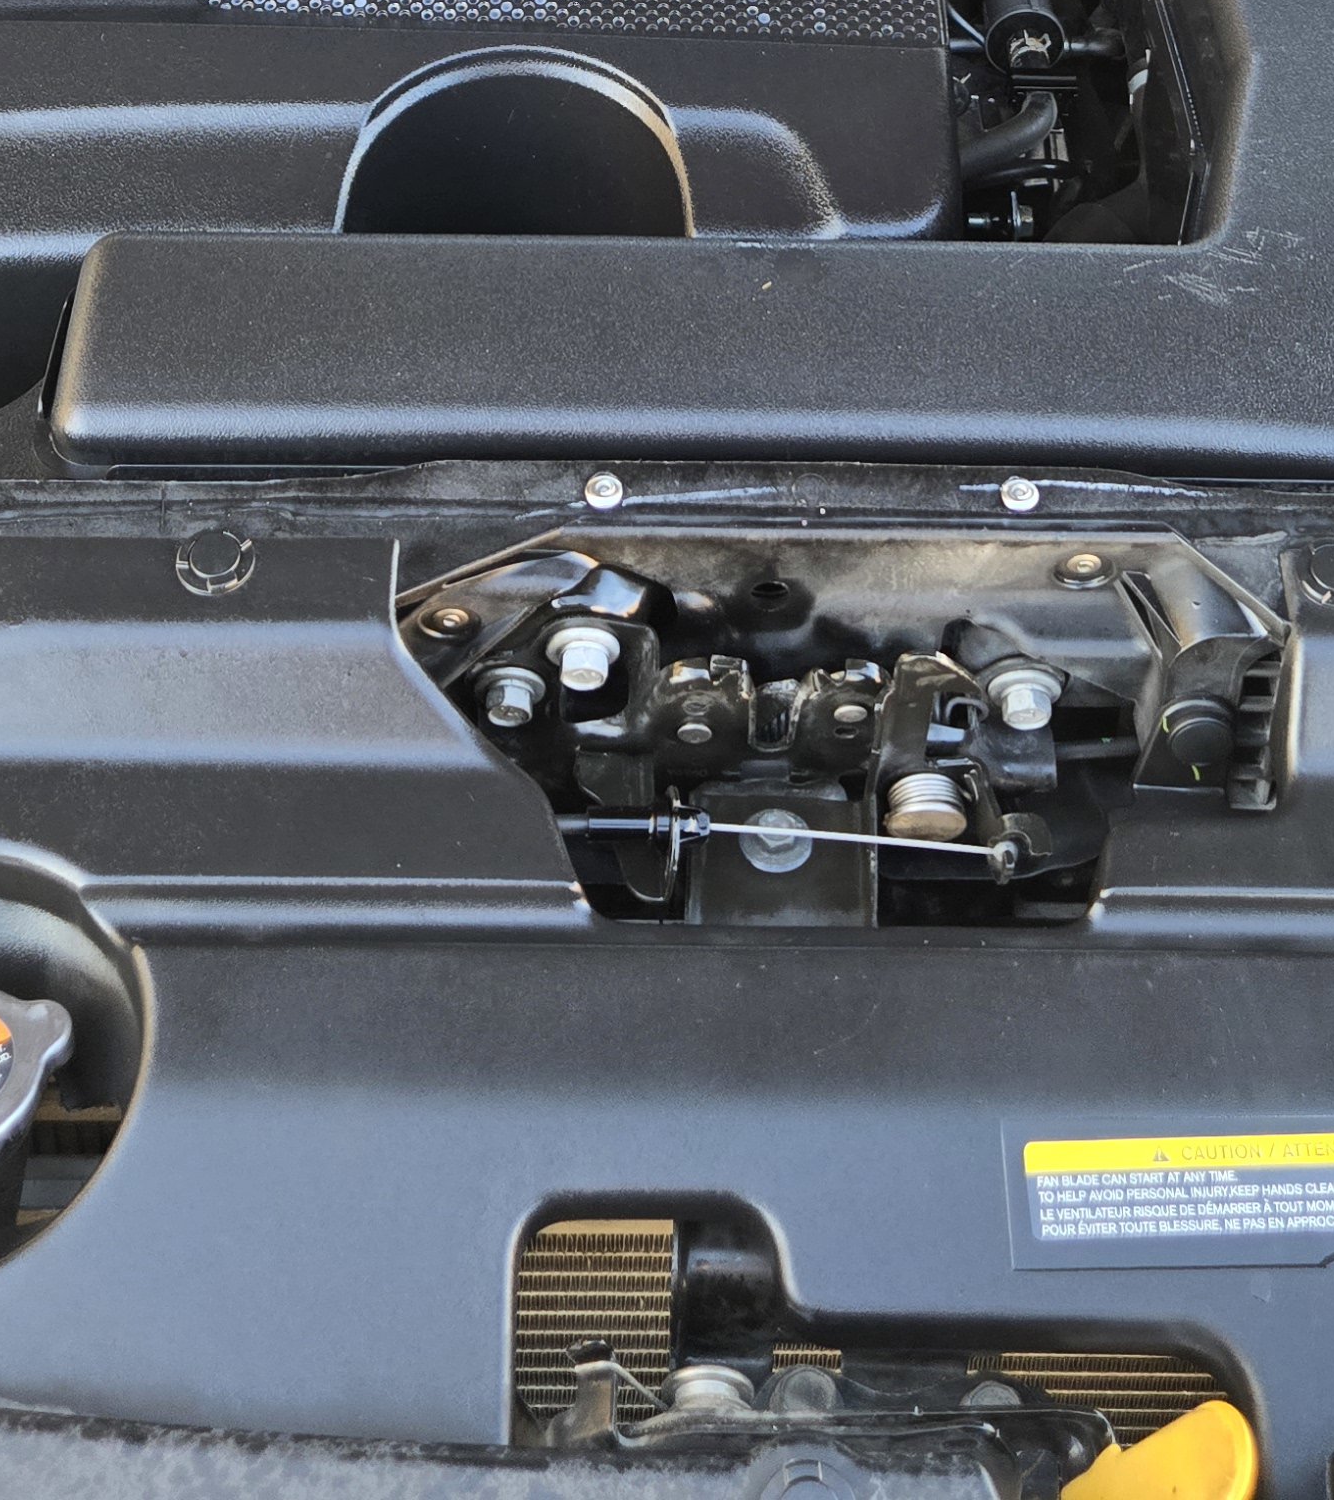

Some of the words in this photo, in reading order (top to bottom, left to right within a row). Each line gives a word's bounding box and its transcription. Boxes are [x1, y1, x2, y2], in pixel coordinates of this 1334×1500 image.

[1182, 1144, 1261, 1161] CAUTION
[1037, 1176, 1059, 1188] FAN
[1062, 1174, 1099, 1186] BLADE
[1102, 1174, 1127, 1184] CAN
[1129, 1172, 1165, 1184] START
[1167, 1172, 1180, 1182] AT
[1183, 1171, 1206, 1182] ANY
[1209, 1170, 1237, 1181] TIME.
[1039, 1191, 1054, 1202] TO
[1057, 1190, 1086, 1202] HELP
[1089, 1189, 1123, 1201] AVOID
[1127, 1187, 1187, 1200] PERSONAL
[1263, 1184, 1302, 1196] HANDS
[1040, 1209, 1055, 1220] LE
[1057, 1206, 1131, 1220] VENTILATEUR
[1133, 1205, 1175, 1218] RISQUE
[1176, 1204, 1195, 1215] DE
[1198, 1201, 1261, 1215] DÉMARRER
[1263, 1199, 1272, 1213] À
[1274, 1200, 1304, 1213] TOUT
[1042, 1224, 1076, 1236] POUR
[1078, 1220, 1117, 1234] ÉVITER
[1119, 1222, 1157, 1232] TOUTE
[1159, 1219, 1222, 1232] BLESSURE,
[1225, 1219, 1241, 1229] NE
[1243, 1218, 1265, 1228] PAS
[1268, 1217, 1284, 1228] EN
